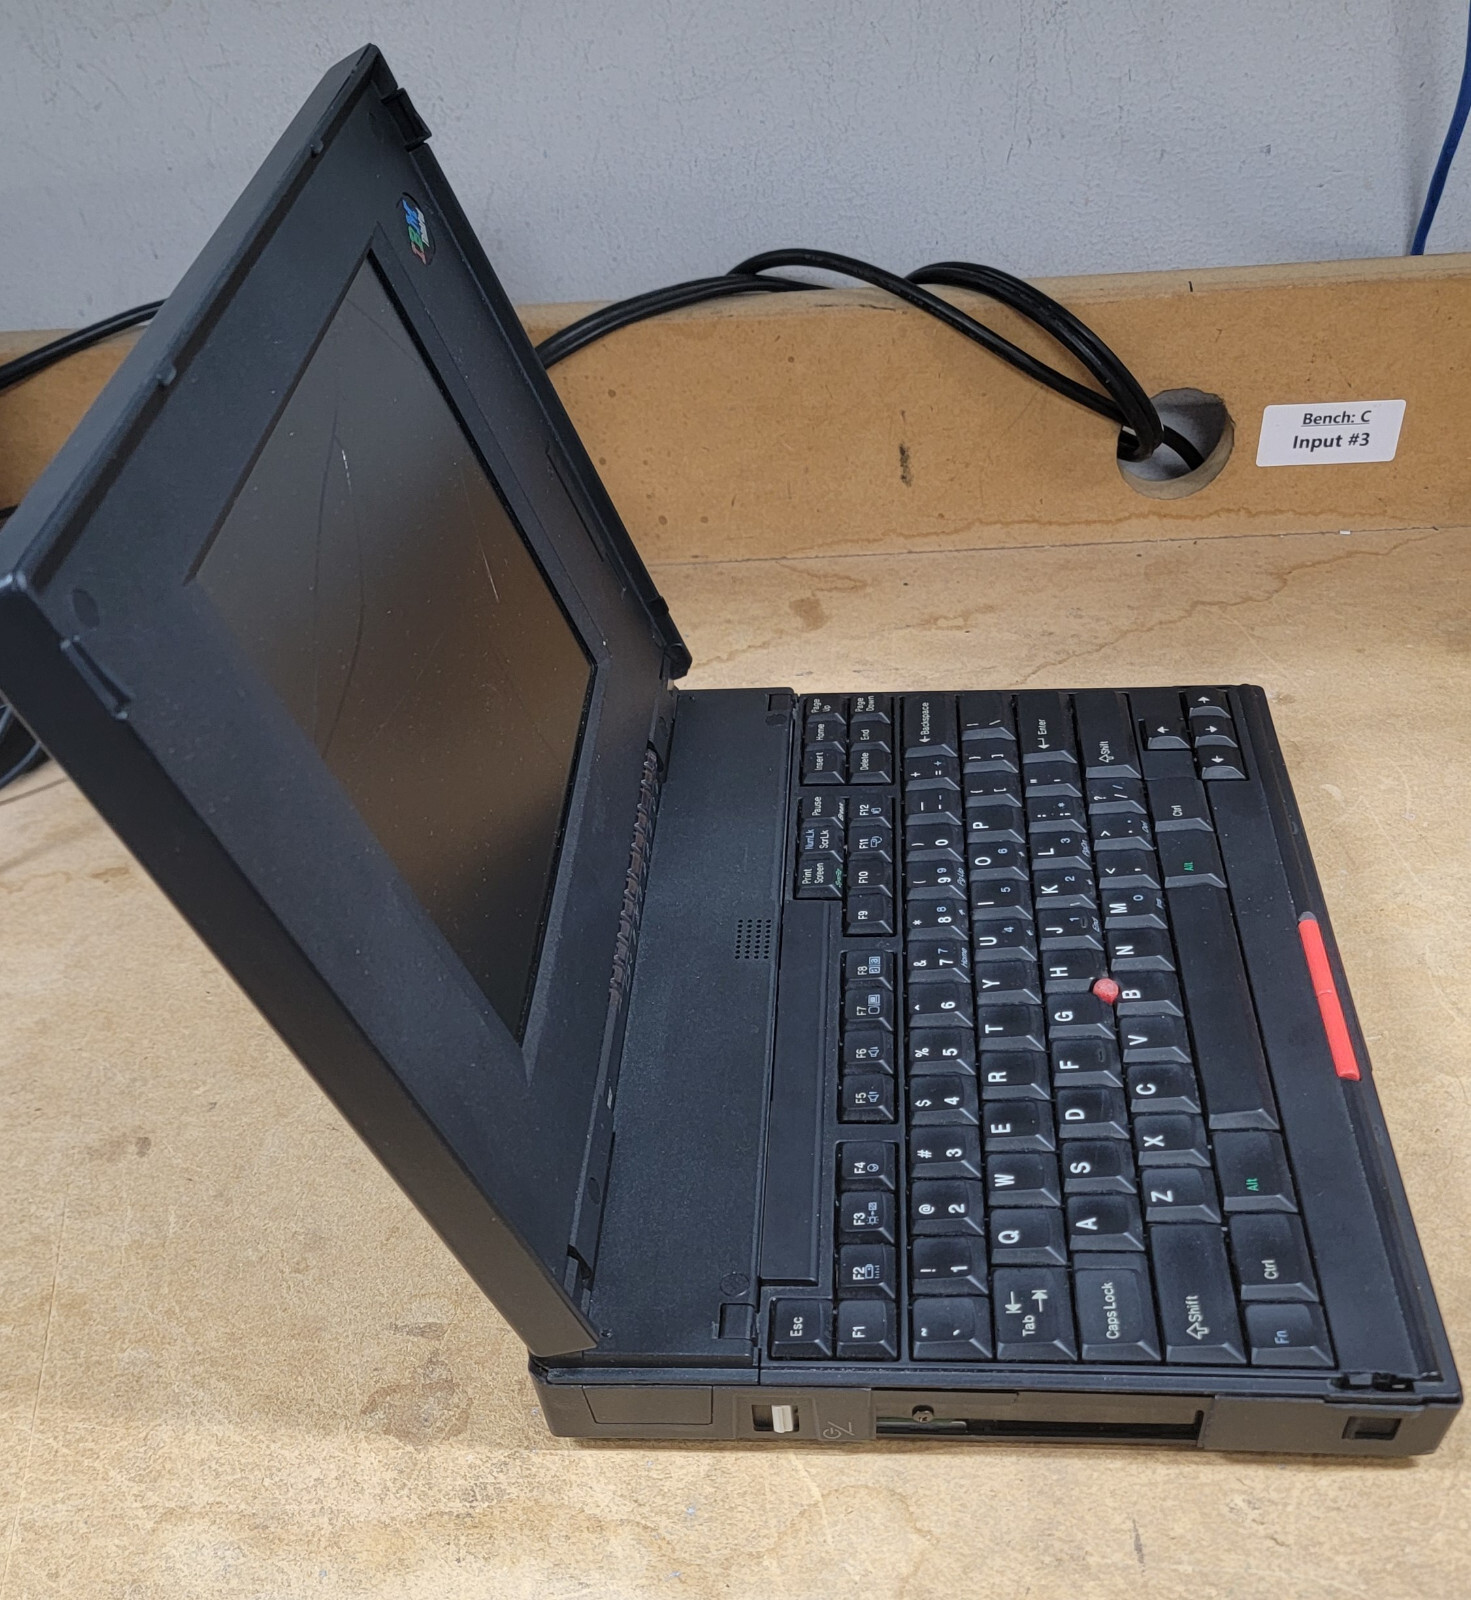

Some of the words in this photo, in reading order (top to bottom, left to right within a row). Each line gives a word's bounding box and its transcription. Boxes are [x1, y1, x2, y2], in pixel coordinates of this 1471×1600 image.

[1303, 411, 1356, 425] Bench:
[1361, 410, 1372, 423] C
[1293, 434, 1343, 452] Input
[1348, 433, 1370, 446] #3
[811, 698, 821, 713] Page
[822, 704, 831, 712] Up
[855, 697, 865, 712] Page
[866, 695, 875, 712] Down
[920, 702, 929, 735] Backspace
[815, 723, 825, 741] Home
[1038, 719, 1047, 735] Enter
[860, 729, 870, 740] End
[1100, 741, 1110, 754] Shift
[814, 751, 824, 771] Insert
[859, 752, 869, 771] Delete
[811, 796, 822, 816] Pause
[859, 804, 869, 816] F12
[1171, 805, 1183, 816] Ctrl
[819, 829, 829, 849] ScrLk
[859, 838, 869, 849] F11
[974, 857, 991, 866] O
[1184, 862, 1194, 871] Alt
[802, 868, 813, 885] Print
[815, 862, 824, 884] Screen
[858, 871, 868, 884] F10
[1041, 884, 1058, 894] K
[1109, 903, 1128, 914] M
[858, 910, 868, 920] F9
[979, 936, 997, 946] U
[1115, 946, 1134, 955] N
[857, 965, 868, 976] F8
[1050, 967, 1068, 977] H
[982, 979, 1000, 988] Y
[1122, 989, 1141, 999] B
[856, 1006, 867, 1016] F7
[1054, 1011, 1073, 1021] G
[985, 1024, 1004, 1034] T
[1128, 1035, 1148, 1045] V
[856, 1048, 867, 1059] F6
[915, 1048, 929, 1057] %
[943, 1048, 957, 1056] 5
[1059, 1060, 1079, 1069] F
[988, 1072, 1007, 1082] R
[1136, 1084, 1156, 1095] C
[855, 1092, 867, 1104] F5
[944, 1097, 960, 1105] 4
[1065, 1109, 1085, 1120] D
[990, 1123, 1011, 1134] E
[1143, 1135, 1165, 1147] X
[917, 1149, 932, 1158] #
[946, 1148, 962, 1157] 3
[854, 1161, 866, 1174] F4
[1070, 1162, 1091, 1174] S
[994, 1174, 1015, 1187] W
[1246, 1178, 1259, 1191] Alt
[1151, 1190, 1173, 1203] Z
[918, 1204, 935, 1214] @
[948, 1204, 965, 1213] 2
[853, 1212, 866, 1226] F3
[1075, 1217, 1098, 1230] A
[998, 1230, 1019, 1244] Q
[852, 1266, 865, 1280] F2
[1261, 1259, 1279, 1279] Ctrl
[1185, 1295, 1203, 1322] Shift
[789, 1316, 803, 1337] Esc
[852, 1325, 866, 1338] F1
[1022, 1315, 1035, 1336] Tab
[1275, 1330, 1289, 1344] Fn
